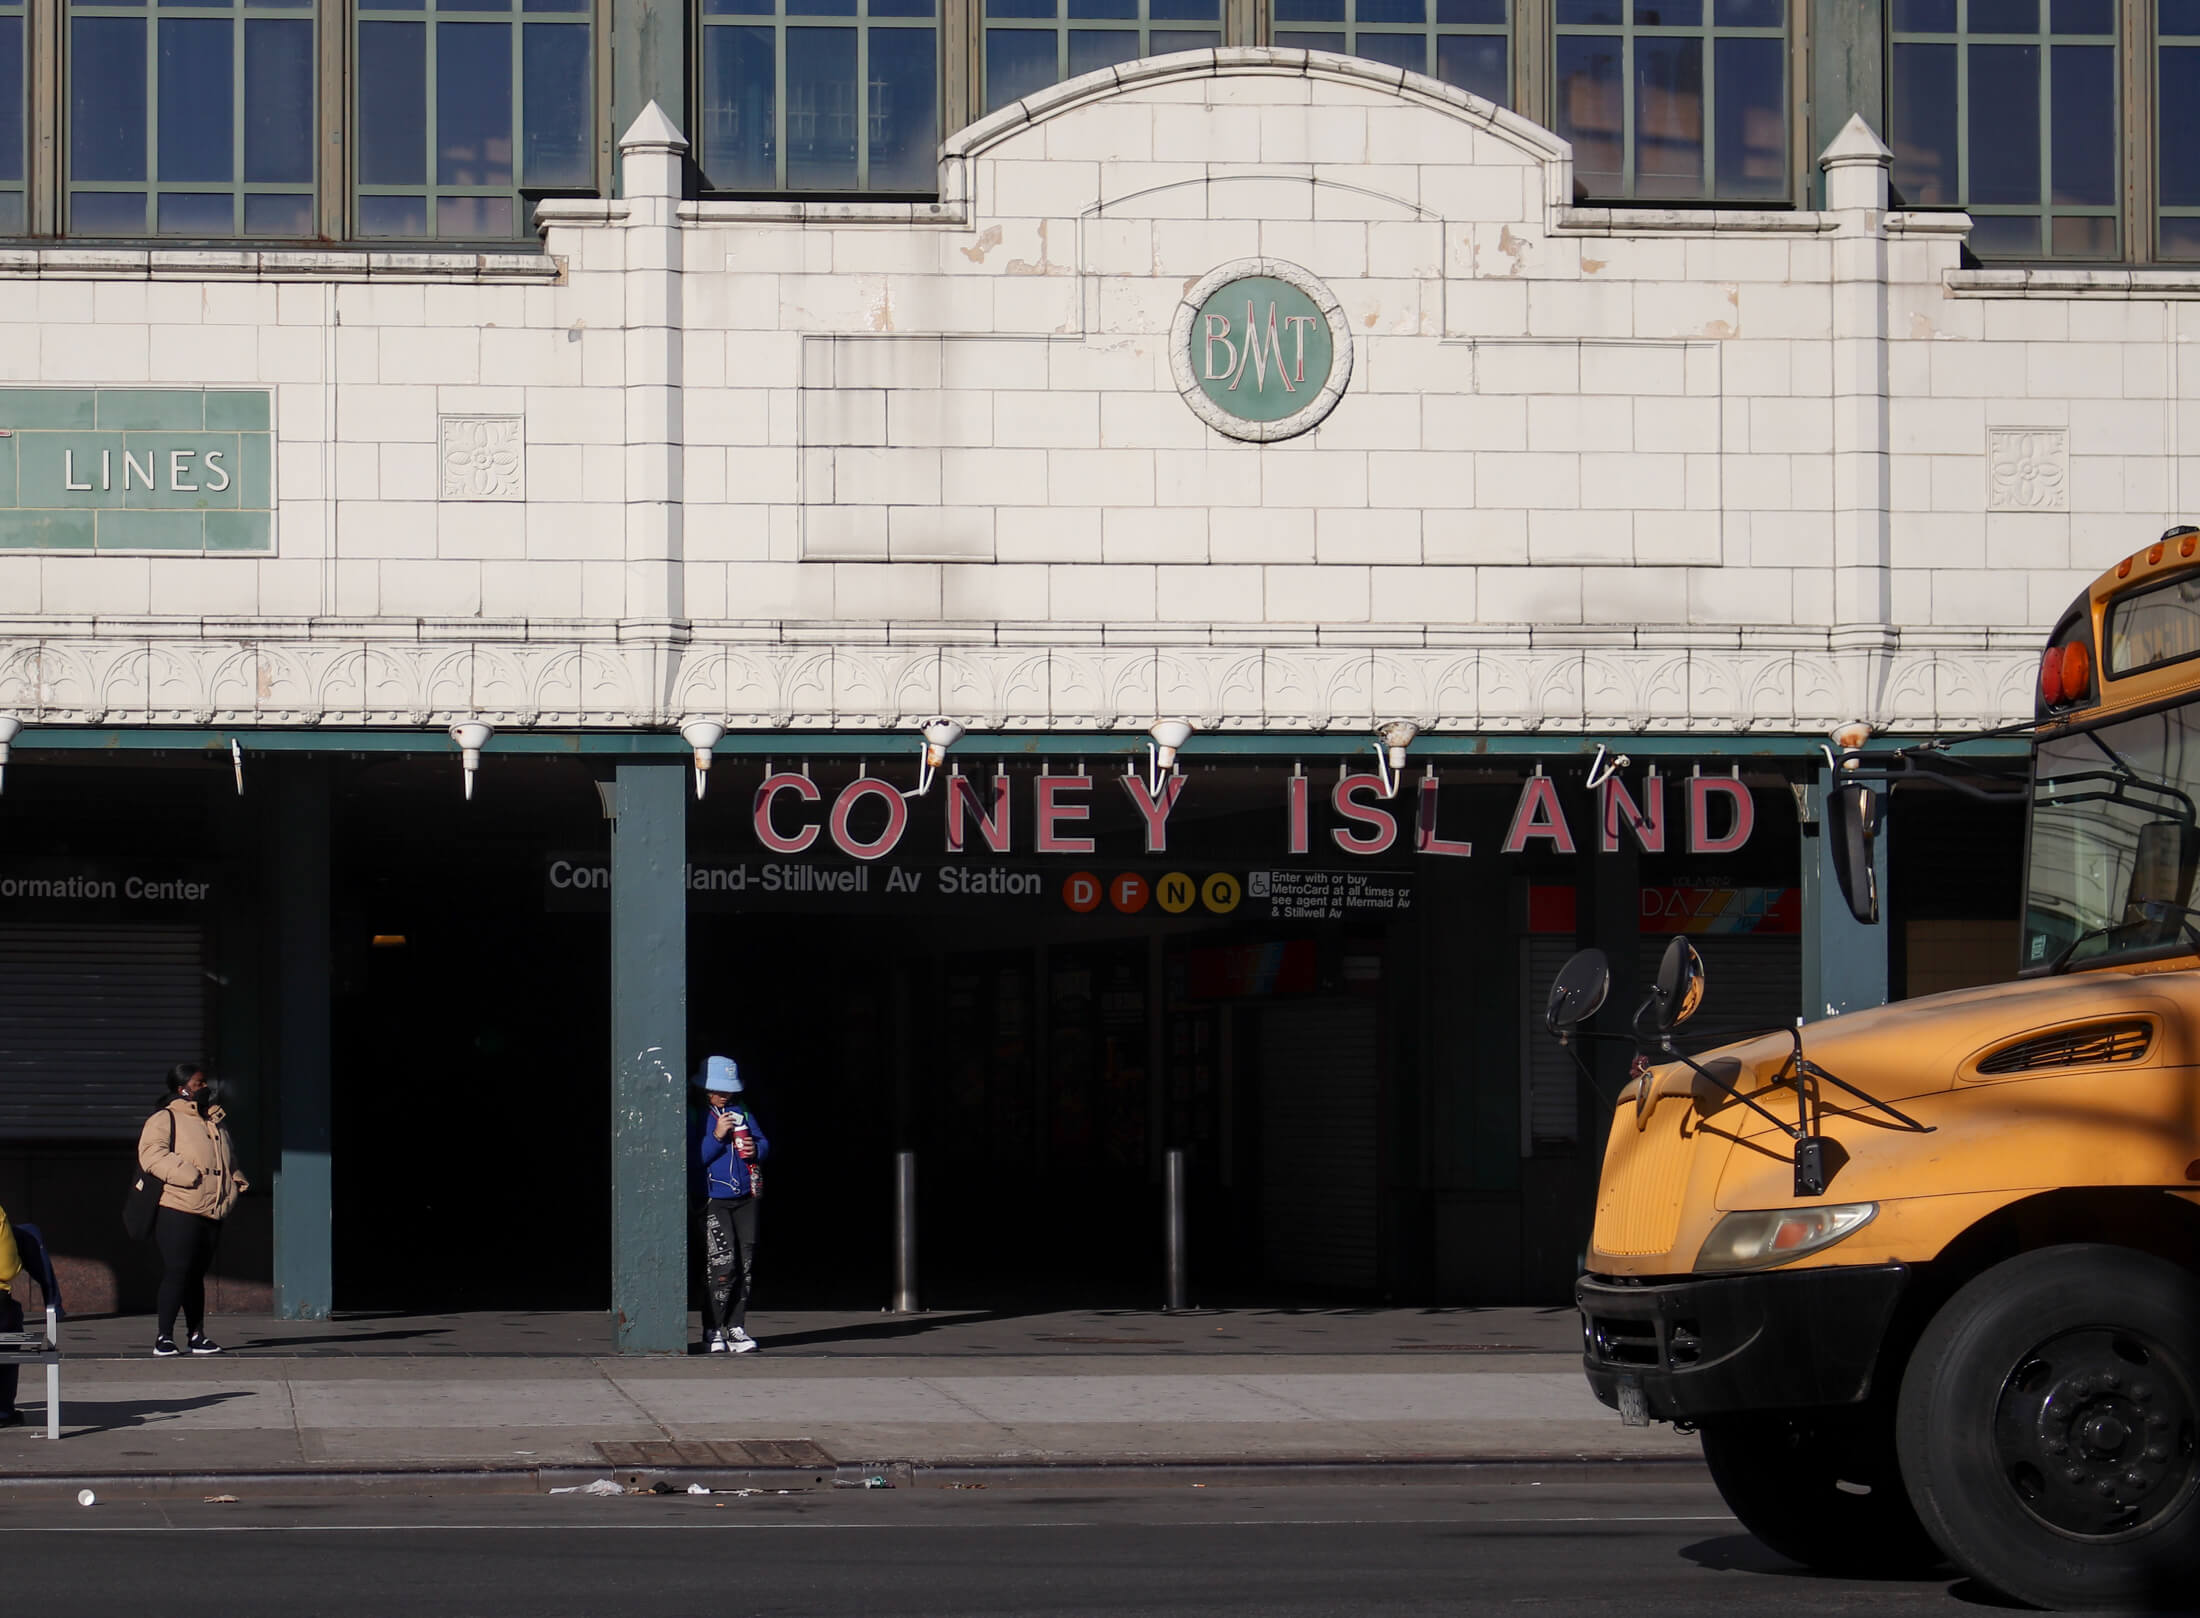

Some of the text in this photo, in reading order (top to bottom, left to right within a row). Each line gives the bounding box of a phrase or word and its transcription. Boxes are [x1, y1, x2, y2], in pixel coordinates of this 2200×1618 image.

[1203, 299, 1317, 392] BMT
[65, 449, 231, 492] LINES
[753, 772, 1755, 859] CONEY ISLAND
[124, 876, 210, 901] Center
[549, 860, 1042, 895] Con land-Stillwell Av Station
[1271, 871, 1368, 887] Enter with or buy
[1271, 883, 1411, 897] MetroCard at all times or
[1074, 879, 1231, 904] D F N Q
[1271, 896, 1411, 908] see agent at Mermaid Av
[1642, 887, 1781, 917] DAZZLE
[1271, 906, 1343, 918] & Stillwell Av
